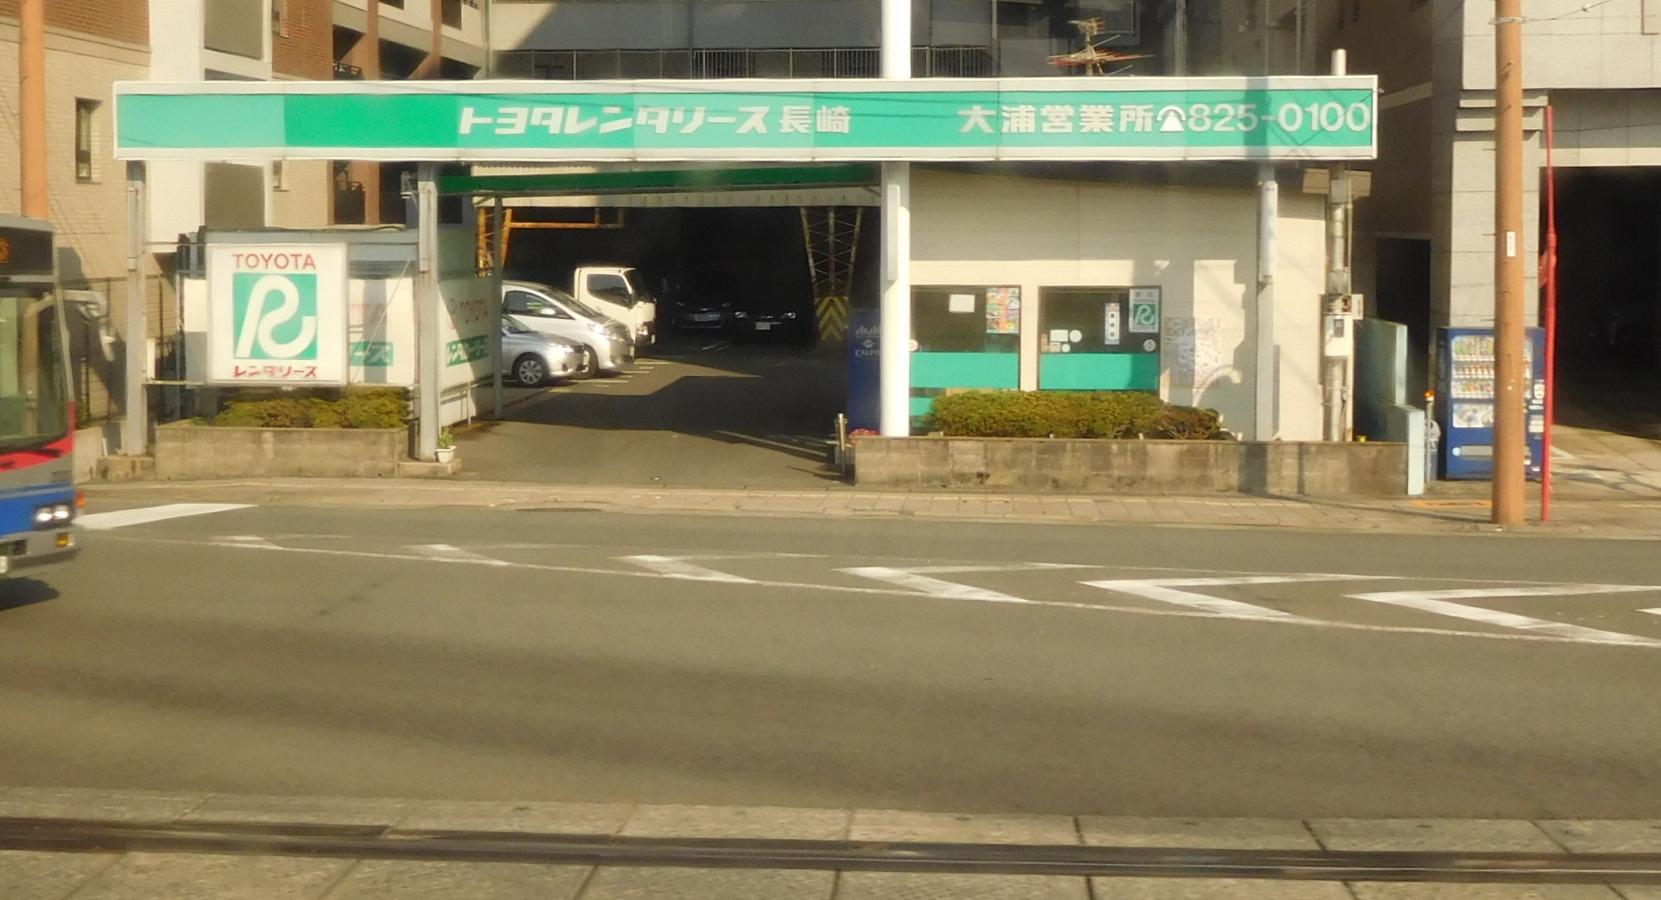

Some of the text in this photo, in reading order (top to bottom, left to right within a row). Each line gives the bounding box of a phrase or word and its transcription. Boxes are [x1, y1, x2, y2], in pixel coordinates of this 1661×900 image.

[958, 102, 1370, 133] 大浦営業所 825-0100
[232, 253, 317, 269] TOYOTA
[233, 365, 318, 378] レンタリース
